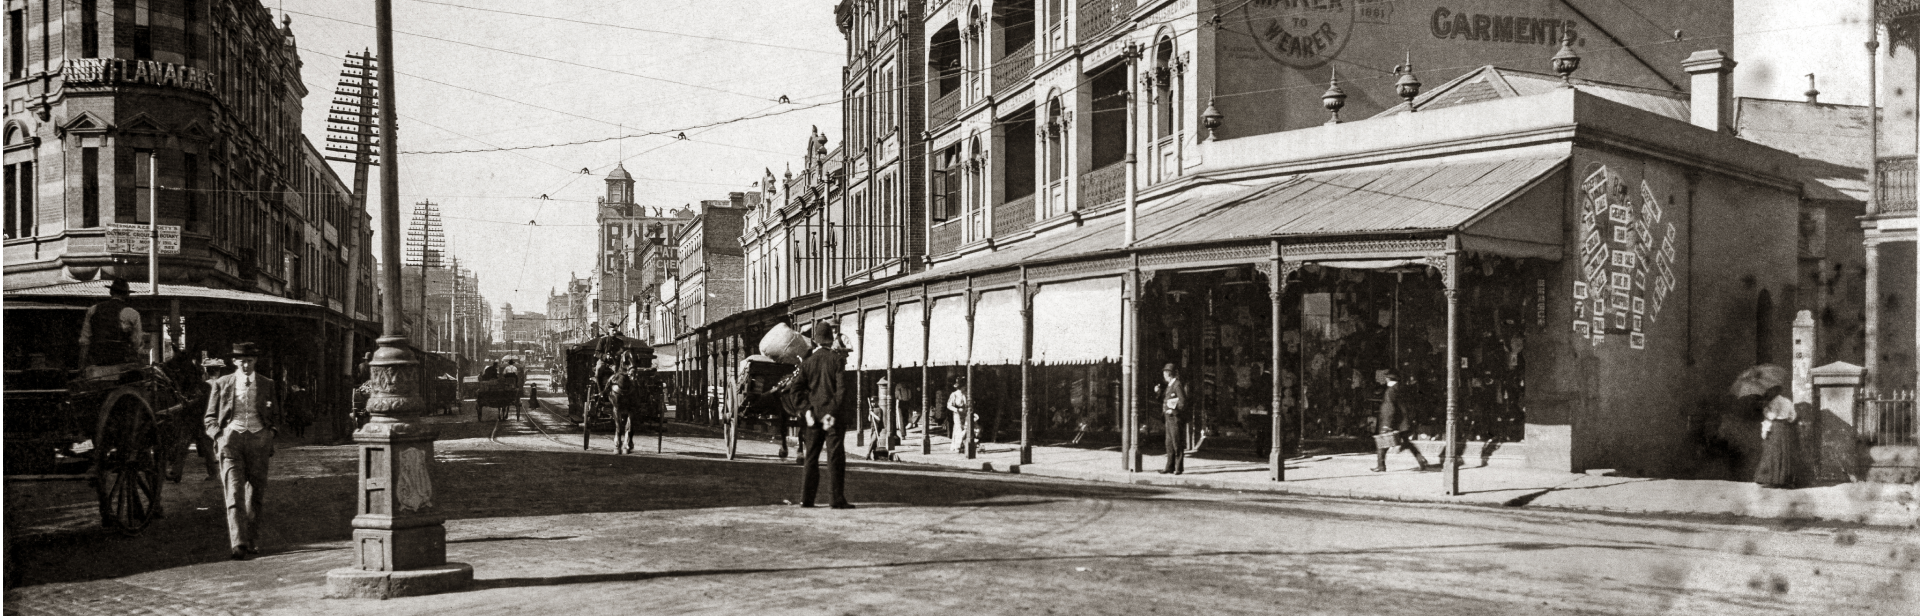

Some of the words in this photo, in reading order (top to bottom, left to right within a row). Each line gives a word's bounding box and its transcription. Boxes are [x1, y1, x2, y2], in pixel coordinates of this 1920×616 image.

[1292, 17, 1308, 27] TO
[1264, 18, 1338, 59] WEARER
[61, 58, 109, 83] ANDY
